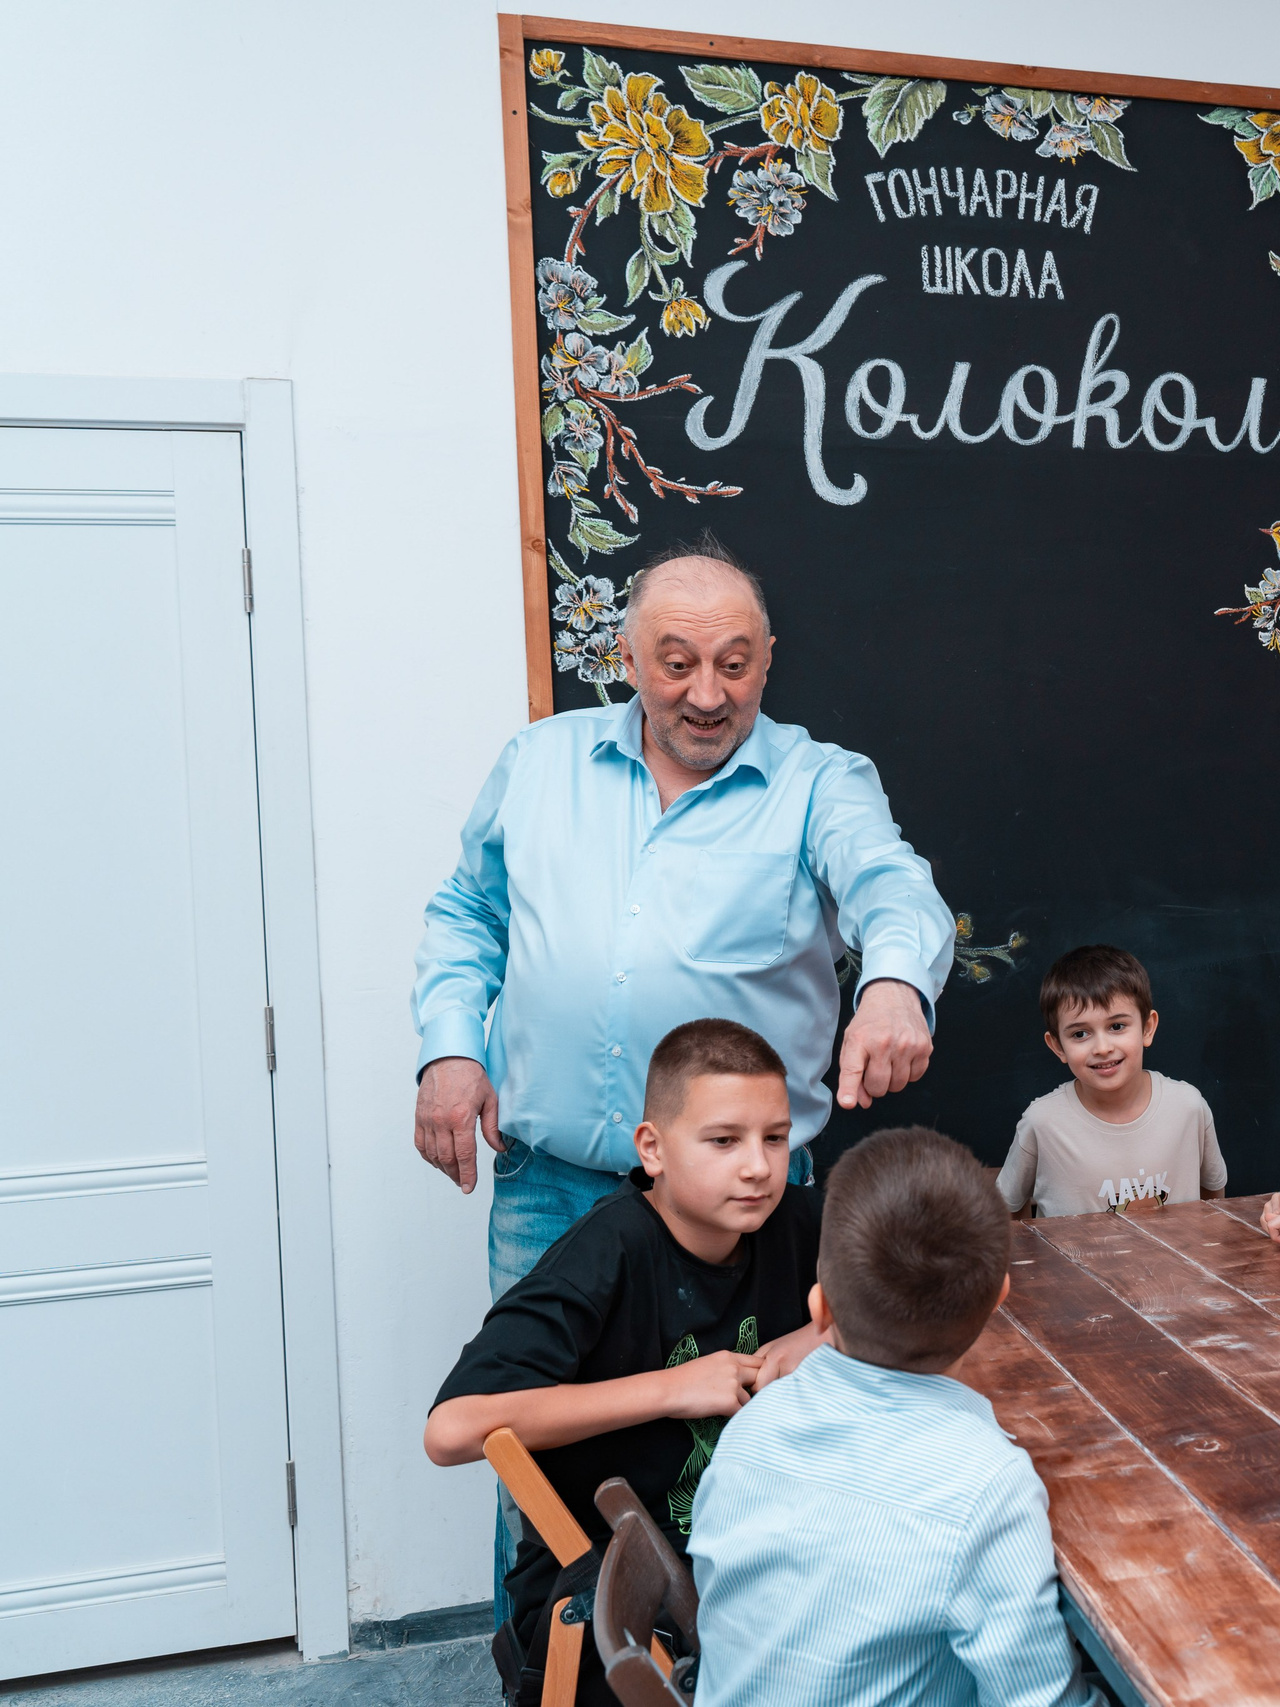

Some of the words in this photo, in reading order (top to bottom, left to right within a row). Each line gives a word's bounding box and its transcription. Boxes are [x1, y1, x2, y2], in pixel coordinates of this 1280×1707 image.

[864, 166, 1099, 235] ГОНЧАРНАЯ
[920, 245, 1065, 300] ШКОЛА
[1098, 1168, 1171, 1206] ЛАЙК
